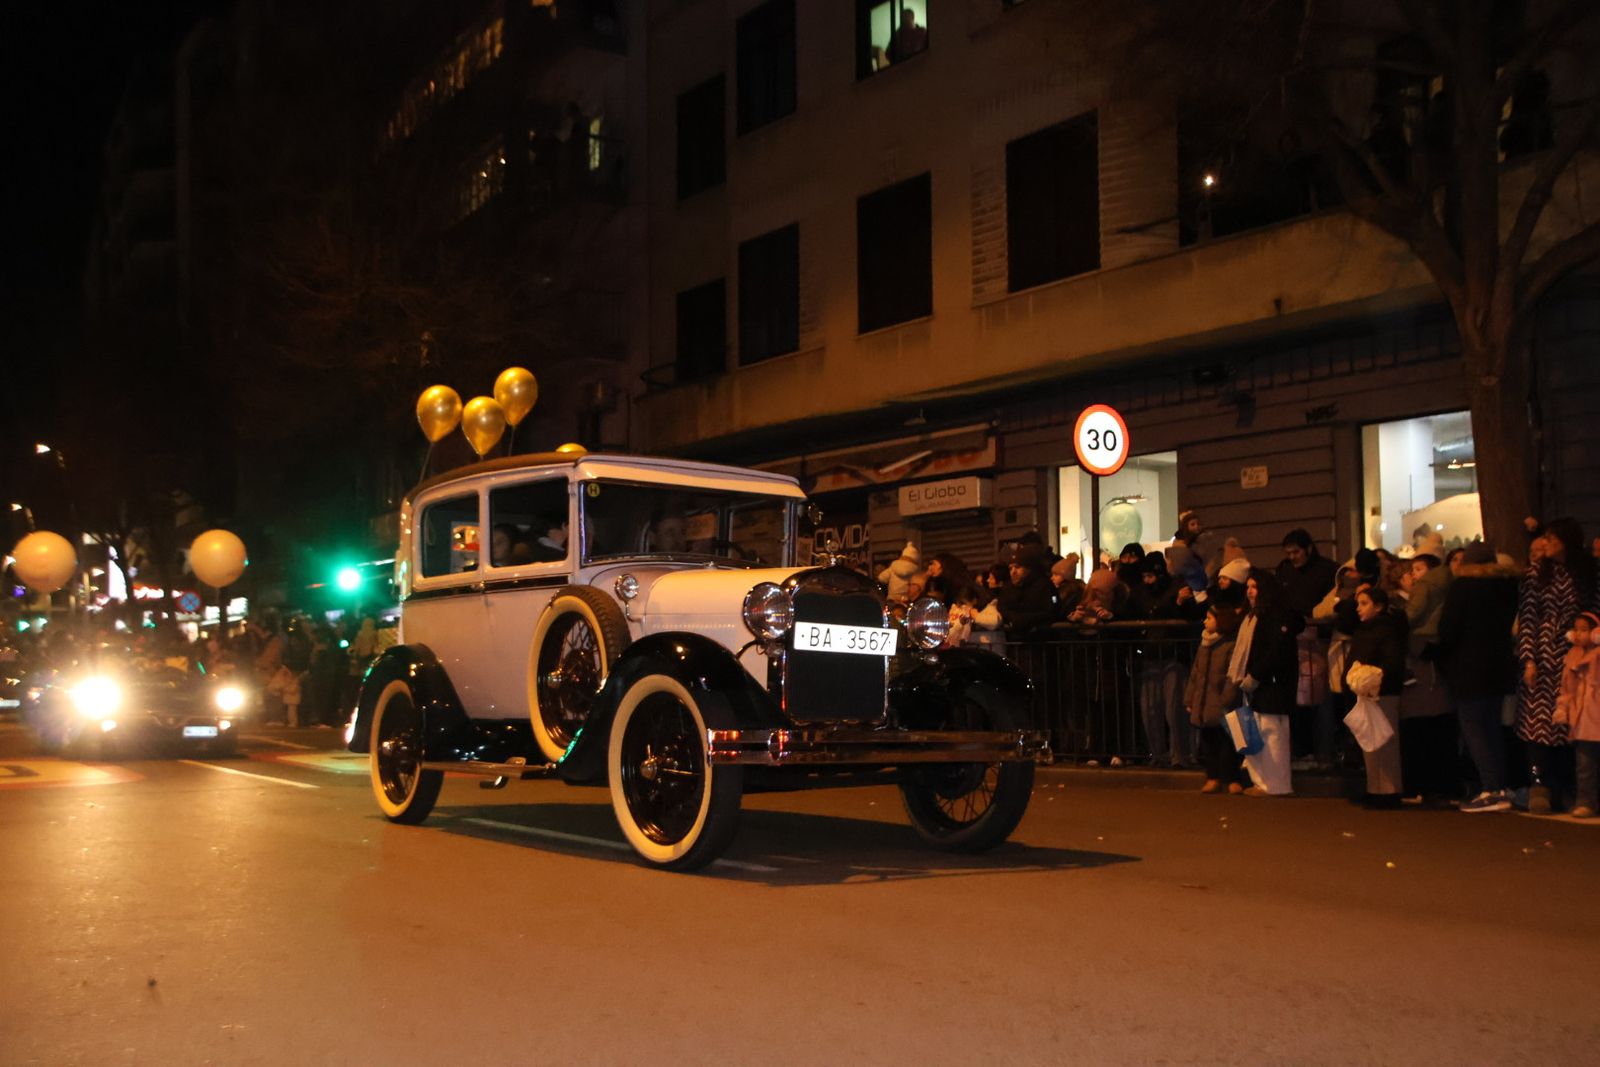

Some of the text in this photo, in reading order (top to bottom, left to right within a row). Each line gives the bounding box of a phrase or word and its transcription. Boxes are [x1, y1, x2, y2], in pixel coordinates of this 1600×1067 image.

[1087, 428, 1117, 451] 30
[908, 485, 967, 502] El Globo
[809, 626, 890, 651] BA 3567
